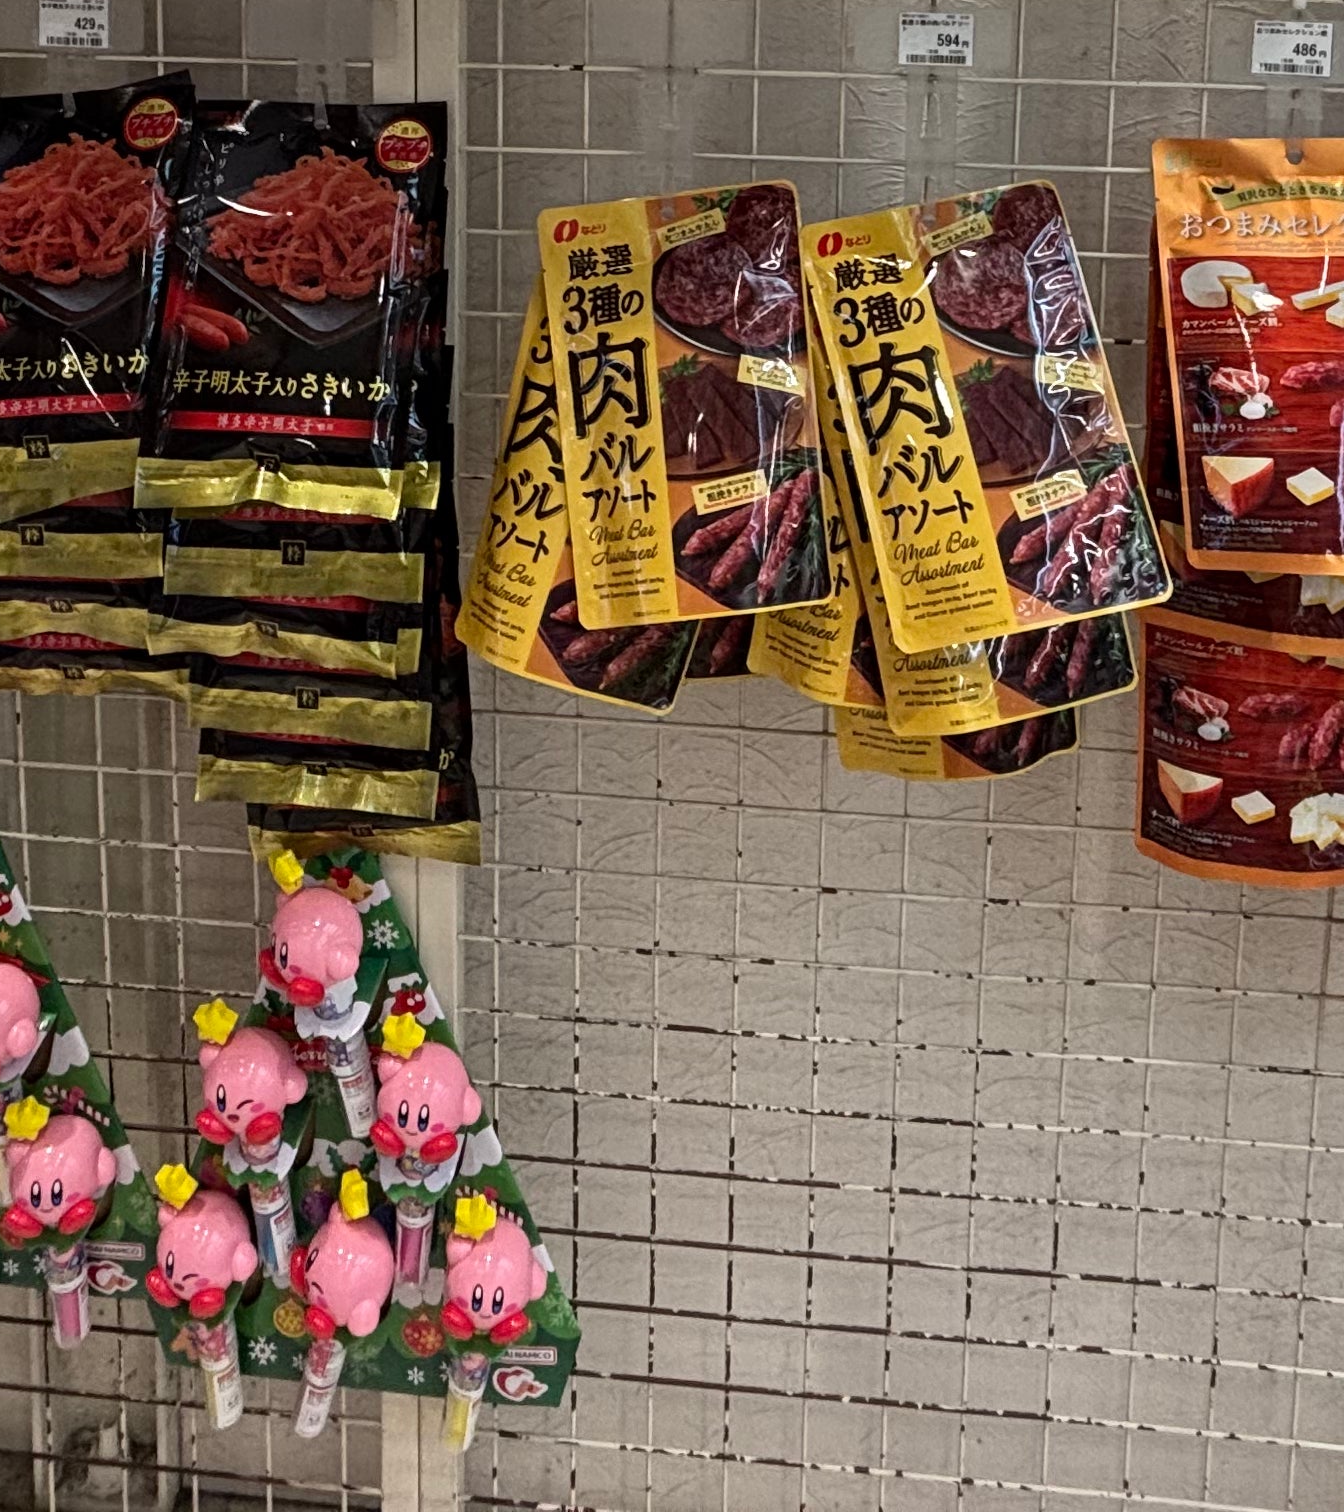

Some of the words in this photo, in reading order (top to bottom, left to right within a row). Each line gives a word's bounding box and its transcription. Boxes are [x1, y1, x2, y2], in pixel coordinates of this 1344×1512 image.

[581, 223, 606, 237] なとり
[846, 234, 872, 247] なとり
[568, 244, 633, 281] 厳選
[834, 252, 904, 293] 厳選
[563, 282, 644, 335] 3種の
[833, 291, 926, 348] 3種の
[173, 369, 391, 402] 辛子明太子入りさきいか
[567, 332, 652, 439] 肉
[849, 342, 954, 456] 肉
[581, 431, 656, 482] バル
[878, 445, 964, 499] バル
[493, 468, 565, 521] バル
[582, 478, 657, 522] アソート
[882, 490, 975, 540] アソート
[488, 512, 550, 563] アソート
[626, 519, 657, 539] Bar
[894, 542, 941, 565] Meat
[946, 530, 980, 554] Bar
[507, 562, 537, 588] Bar
[900, 554, 985, 586] Assortment
